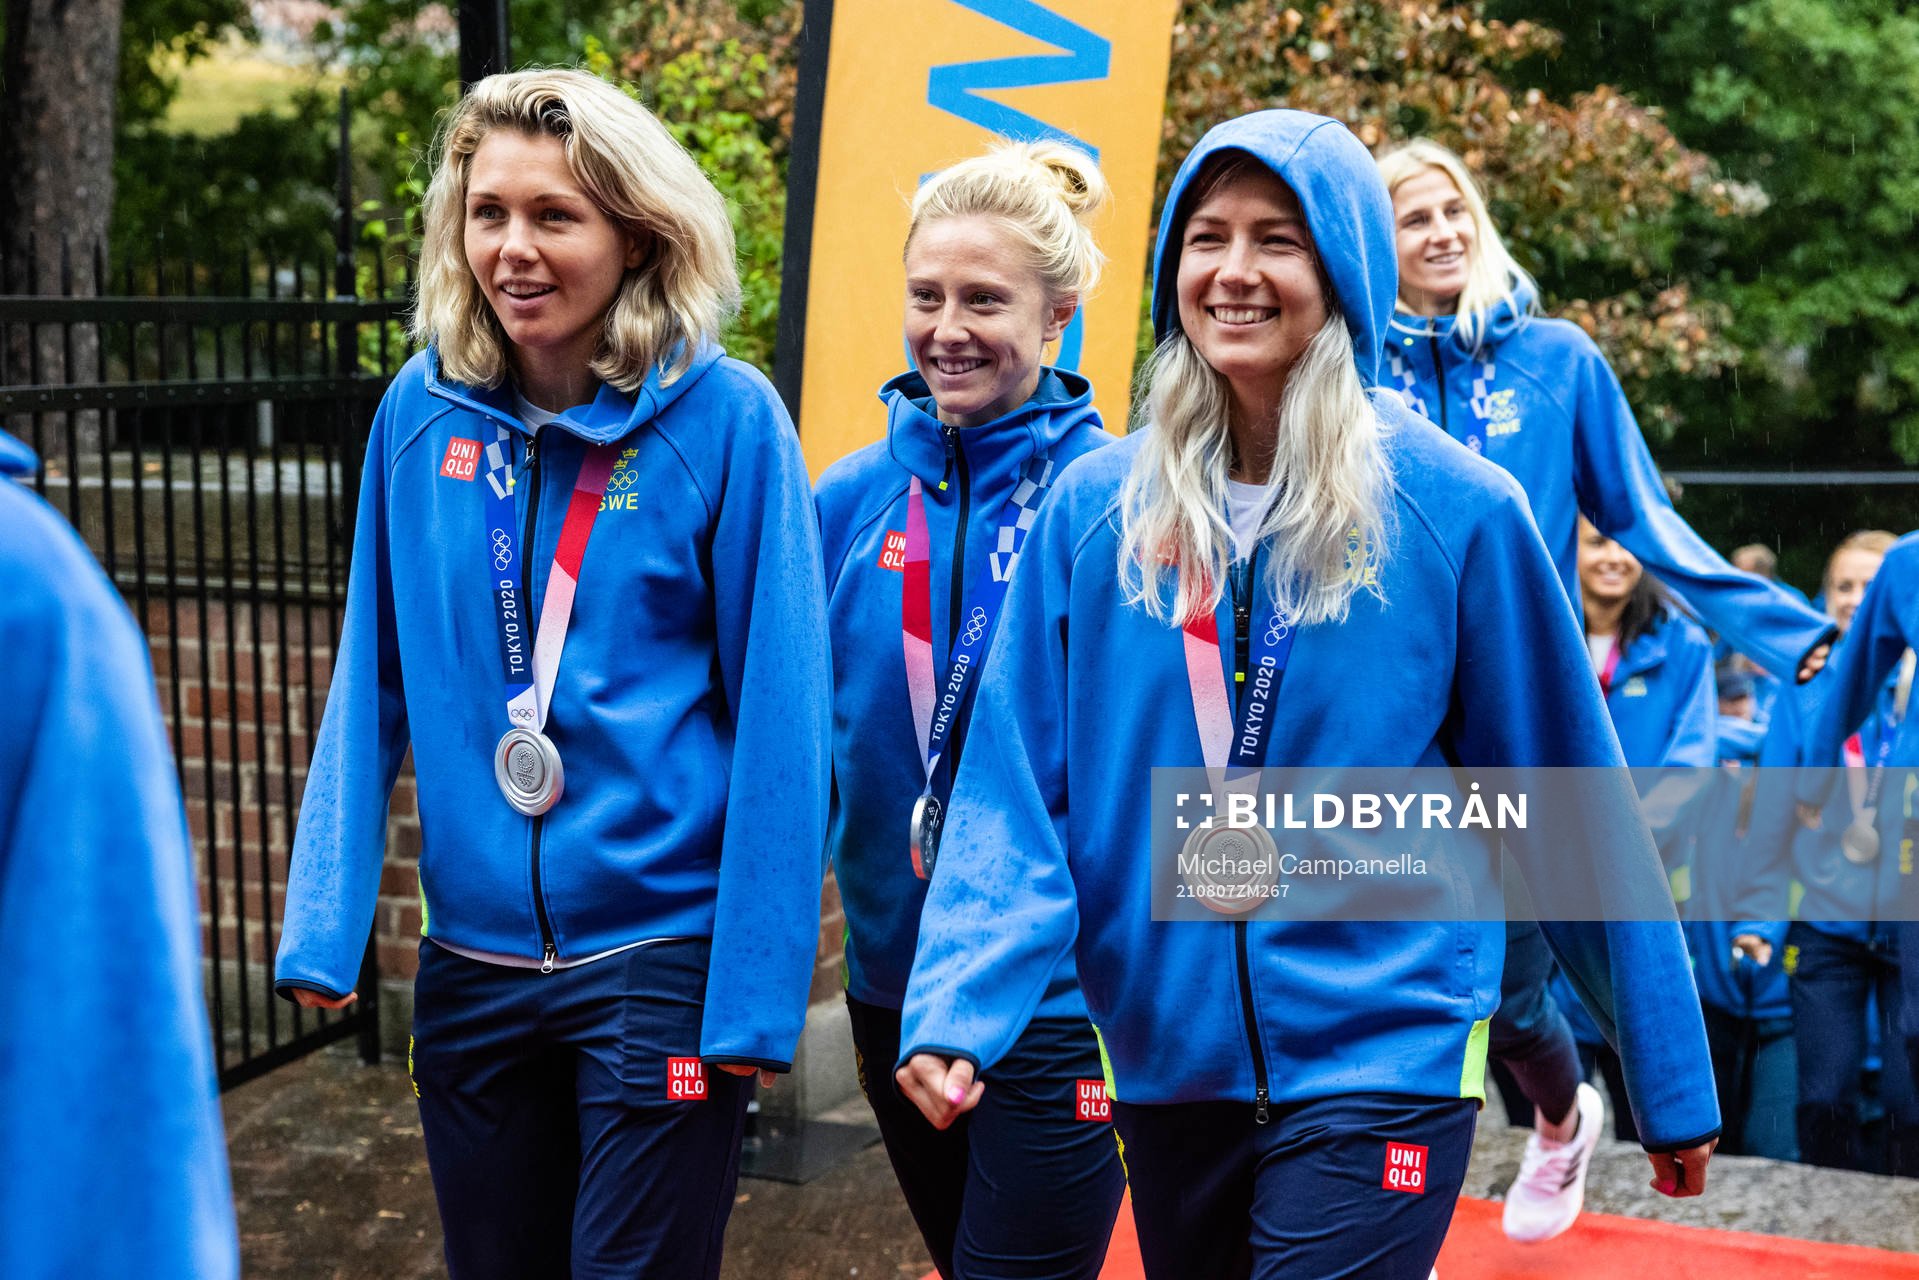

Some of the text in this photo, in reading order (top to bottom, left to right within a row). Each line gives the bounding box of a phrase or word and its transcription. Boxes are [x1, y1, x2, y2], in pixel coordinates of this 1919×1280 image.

[1486, 418, 1521, 437] SWE
[451, 442, 476, 459] UNI
[446, 458, 474, 477] QLO
[888, 534, 906, 551] UN
[501, 579, 524, 674] TOKYO 2020
[932, 654, 970, 741] TOKYO 2020
[1240, 656, 1277, 757] TOKYO 2020
[672, 1062, 702, 1078] UNI
[672, 1079, 706, 1097] QLO
[1080, 1084, 1107, 1099] UNI
[1080, 1100, 1109, 1118] QLO
[1390, 1148, 1421, 1168] UNI
[1388, 1167, 1422, 1190] QLO
